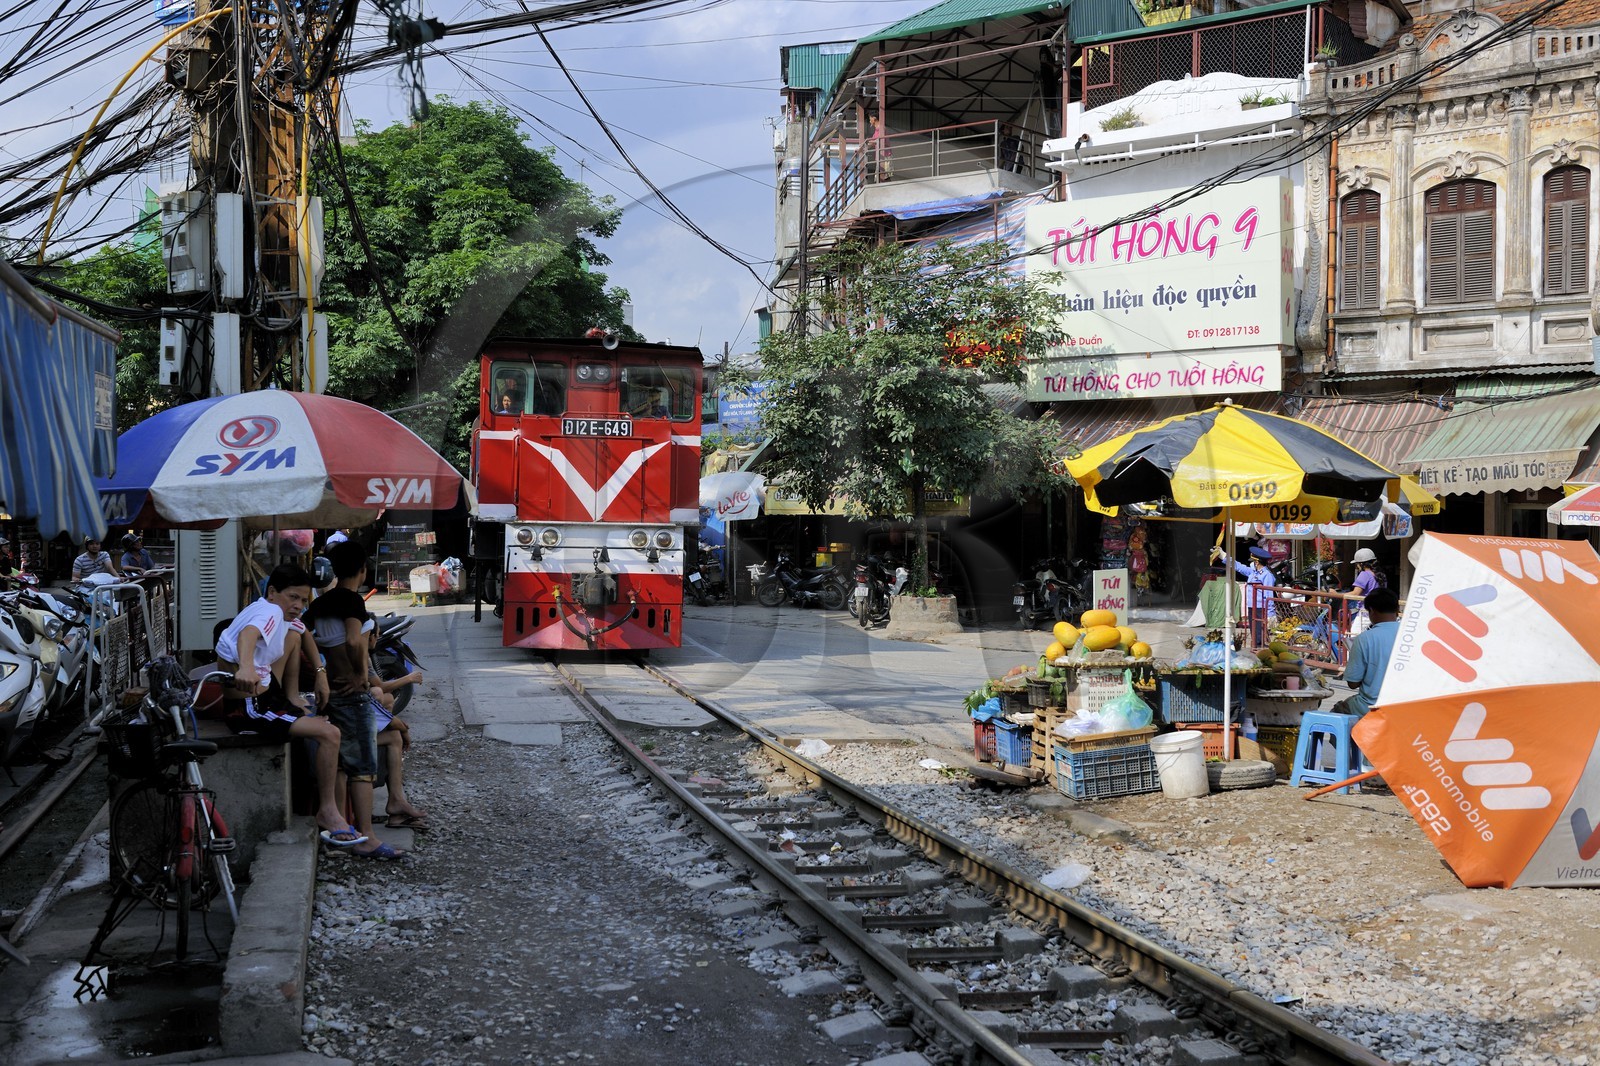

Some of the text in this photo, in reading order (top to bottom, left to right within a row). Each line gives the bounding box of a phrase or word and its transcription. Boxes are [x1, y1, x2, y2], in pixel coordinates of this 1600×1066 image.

[1047, 204, 1260, 266] TÚI HỒNG 9
[1102, 288, 1145, 314] hiệu
[1152, 284, 1187, 311] độc
[1196, 275, 1257, 307] quyền
[1187, 325, 1260, 339] ĐT: 0912817138
[1043, 360, 1265, 393] TÚI HỒNG CHO TUỔI HỒNG
[186, 446, 297, 476] SYM
[1420, 466, 1439, 485] HIẾT
[1443, 463, 1461, 483] KẾ
[1465, 466, 1488, 486] TẠO
[1493, 460, 1519, 480] MẪU
[1523, 459, 1545, 477] TÓC
[363, 477, 432, 506] SYM
[1229, 480, 1278, 501] 0199
[1269, 504, 1312, 521] 0199
[1468, 536, 1566, 549] Vietnamobile
[1102, 576, 1121, 590] TÚI
[1097, 594, 1125, 610] HỒNG
[1394, 573, 1435, 672] Vietnamobile
[1411, 733, 1494, 842] Vietnamobile
